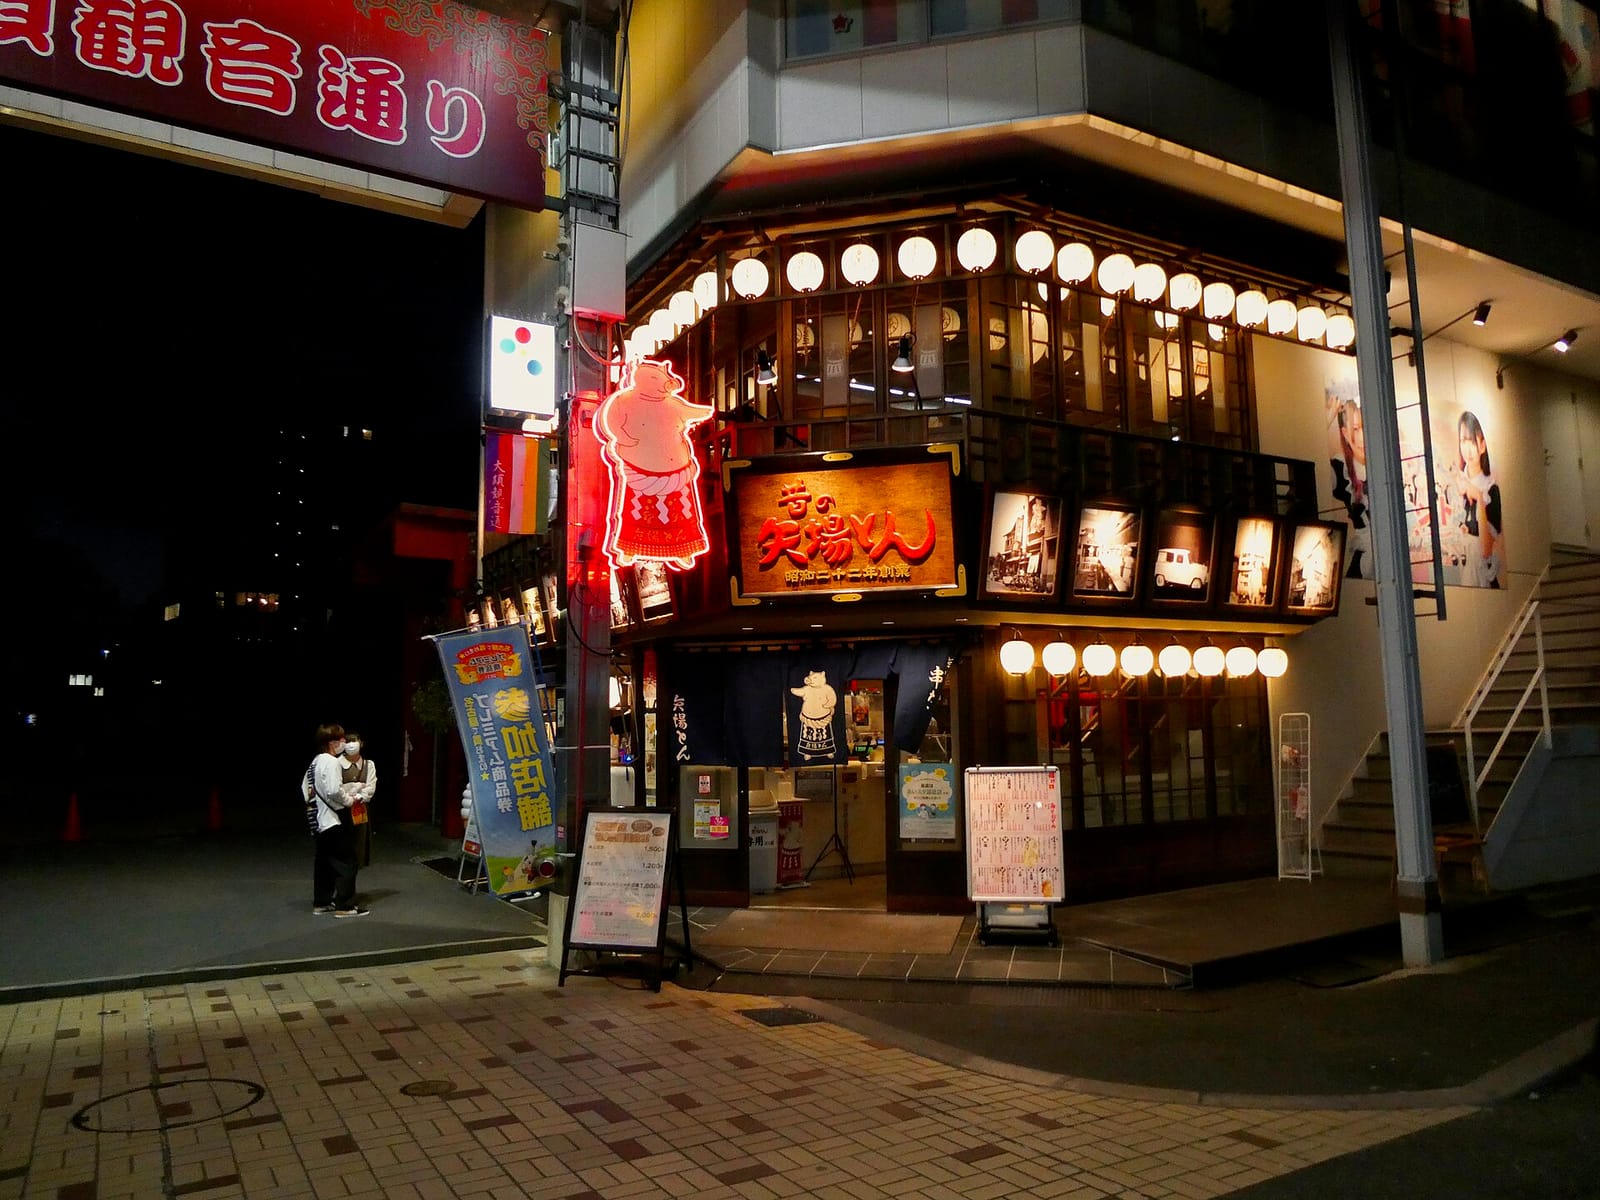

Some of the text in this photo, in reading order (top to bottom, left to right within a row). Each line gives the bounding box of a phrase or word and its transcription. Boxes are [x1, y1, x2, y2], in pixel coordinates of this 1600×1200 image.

[777, 479, 837, 519] 昔の
[757, 507, 937, 566] 矢場とん
[784, 563, 912, 584] 昭和二十二年創業
